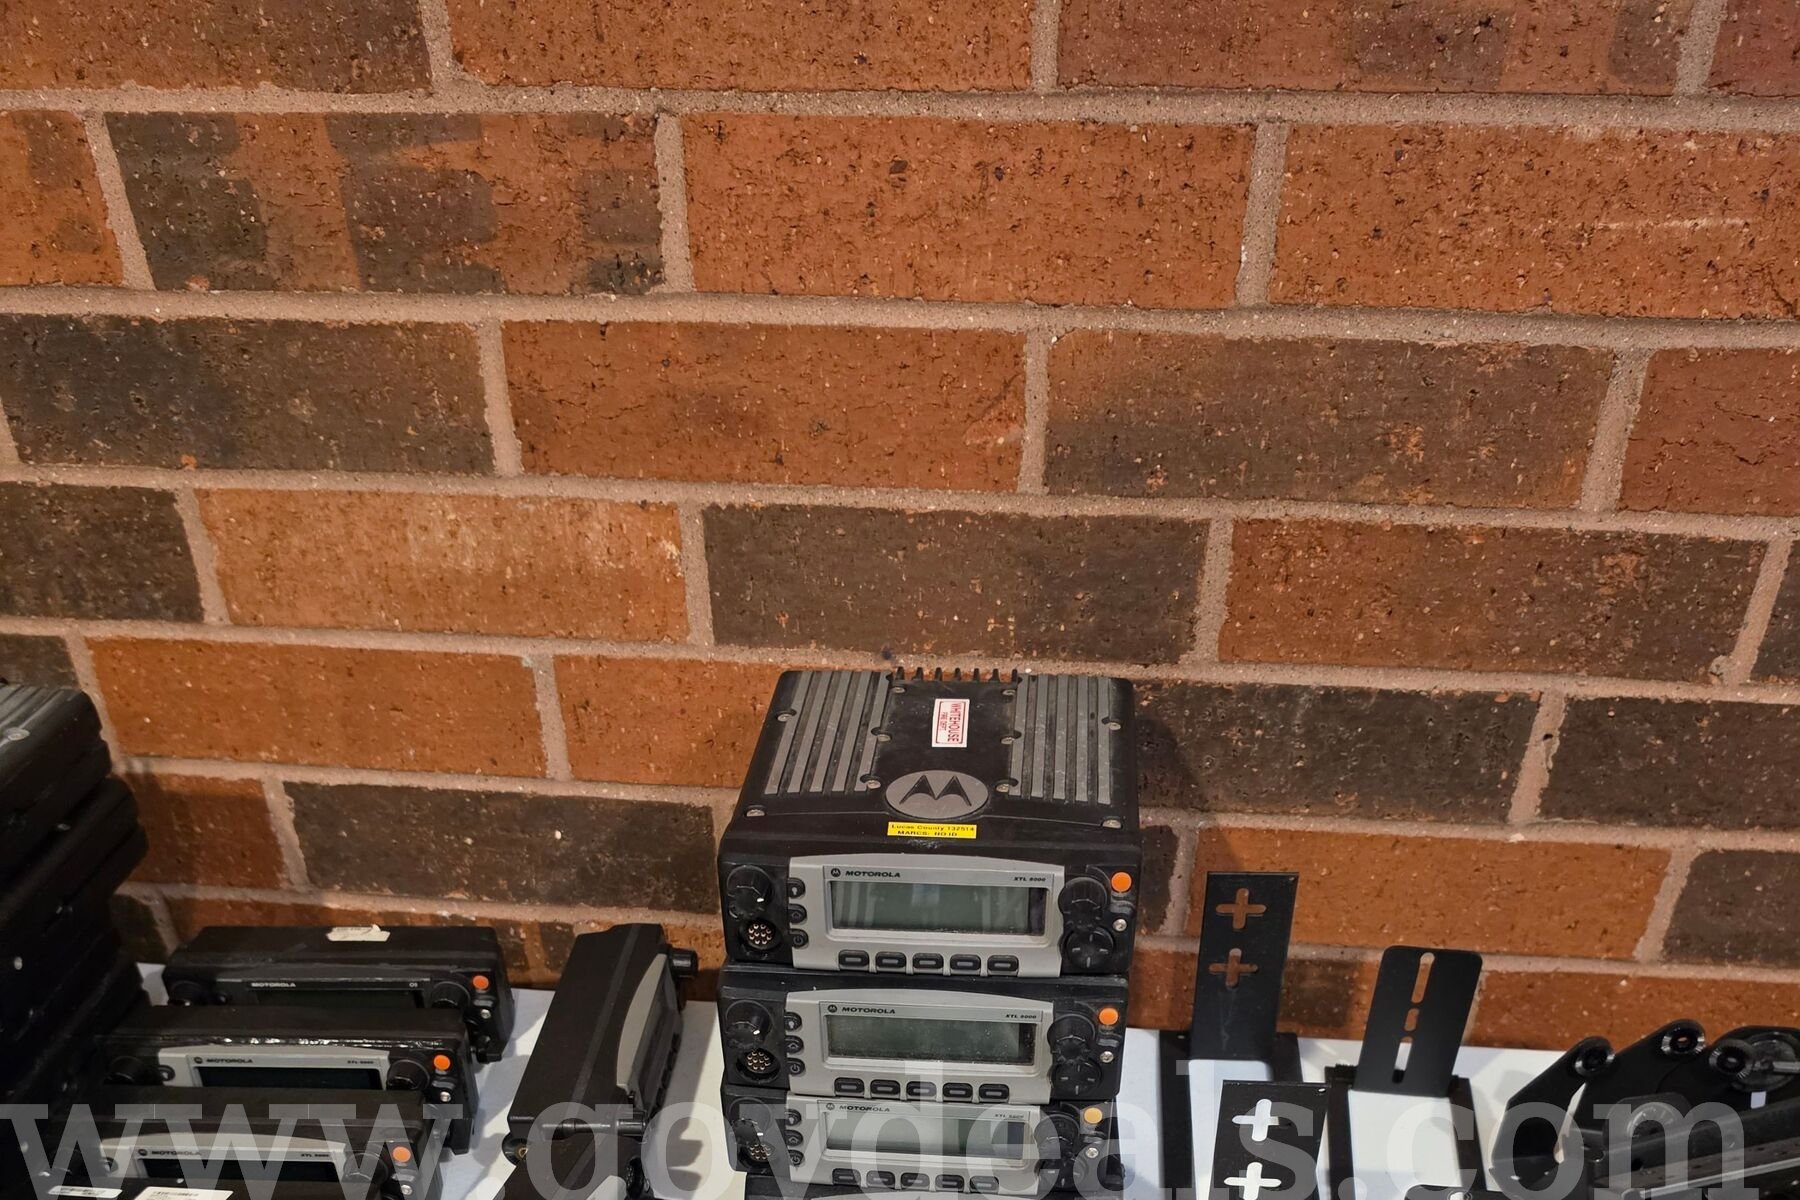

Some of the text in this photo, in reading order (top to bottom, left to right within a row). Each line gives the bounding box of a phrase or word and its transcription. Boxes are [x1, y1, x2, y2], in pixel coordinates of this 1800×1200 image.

[947, 703, 962, 742] WHITEHOUSE
[845, 870, 901, 879] MOTOROLA
[842, 1006, 896, 1015] MOTOROLA
[839, 1104, 891, 1112] MOTOROLA
